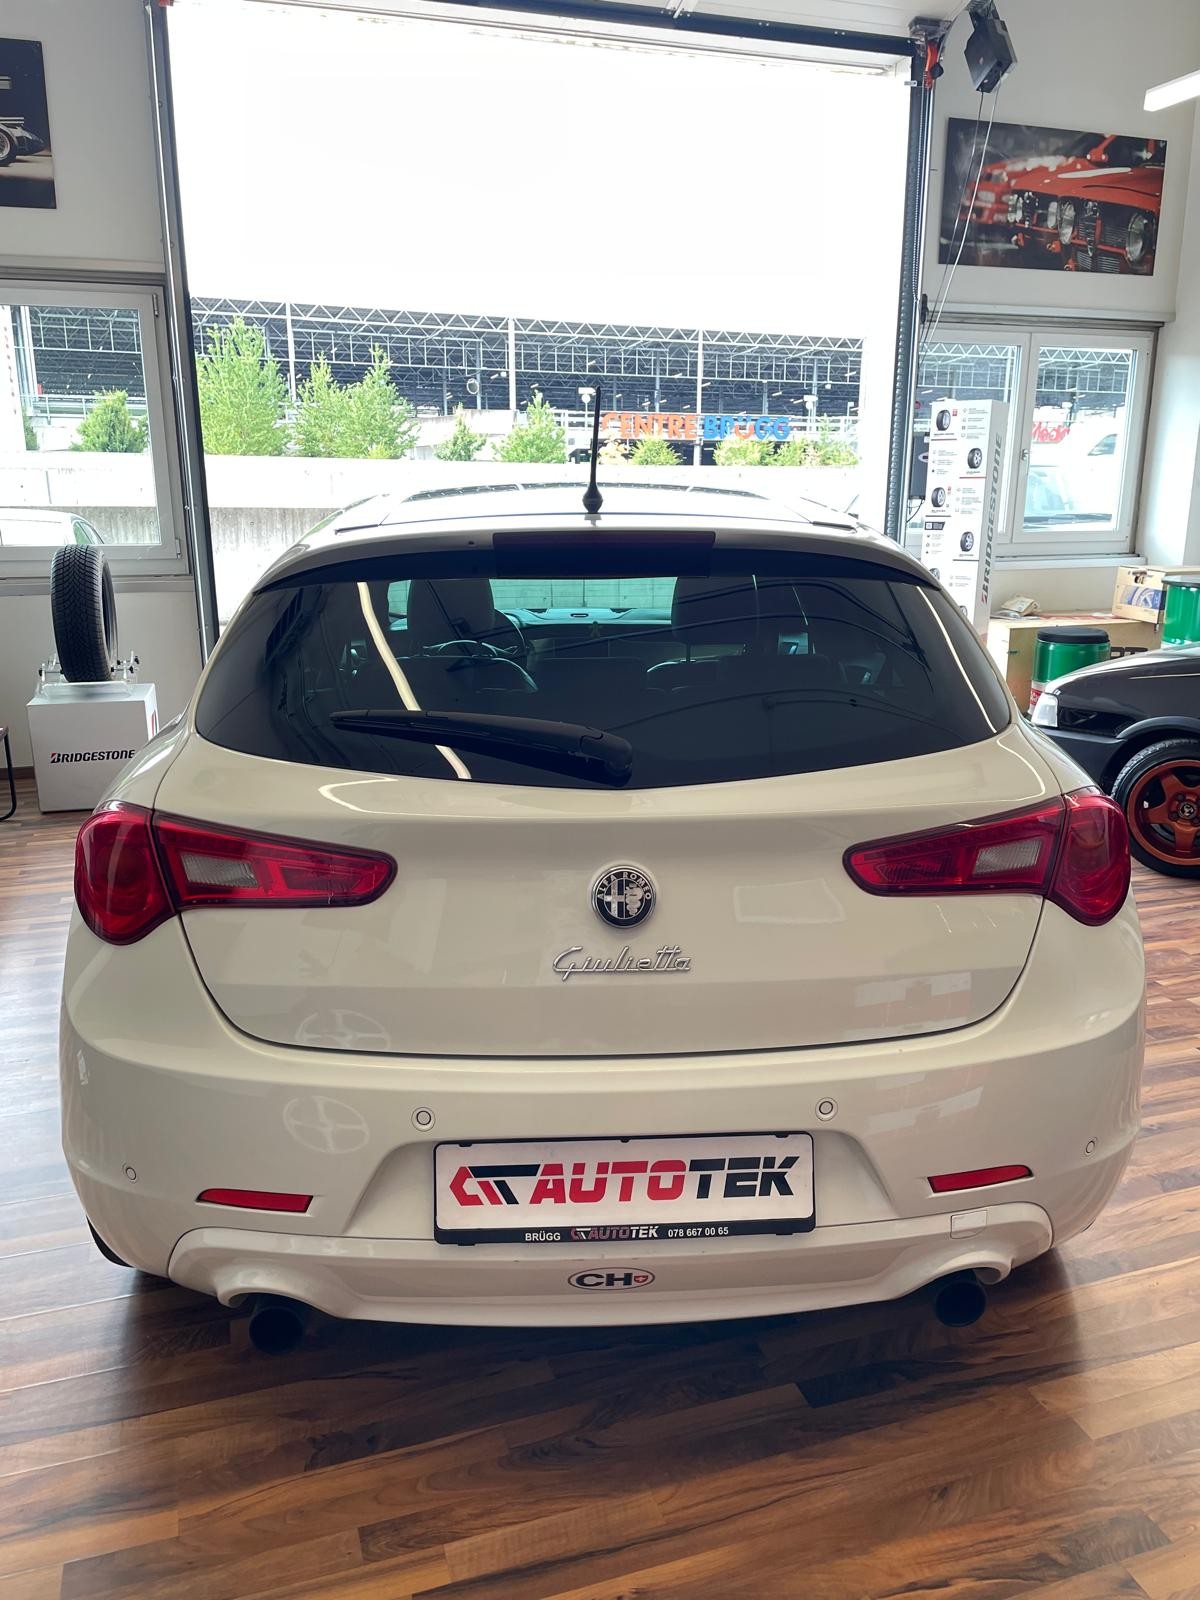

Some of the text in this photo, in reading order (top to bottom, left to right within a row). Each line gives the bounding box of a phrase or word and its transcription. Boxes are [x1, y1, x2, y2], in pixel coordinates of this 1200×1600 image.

[981, 434, 1002, 604] BRIDGESTONE
[50, 749, 135, 763] BRIDGESTONE
[597, 872, 652, 900] ALFA ROMEO
[553, 945, 692, 982] Giulietta
[529, 1156, 800, 1205] AUTOTEK
[525, 1226, 729, 1241] BRÜGG AUTOTEK 078 667 00 65
[576, 1272, 633, 1287] CH
